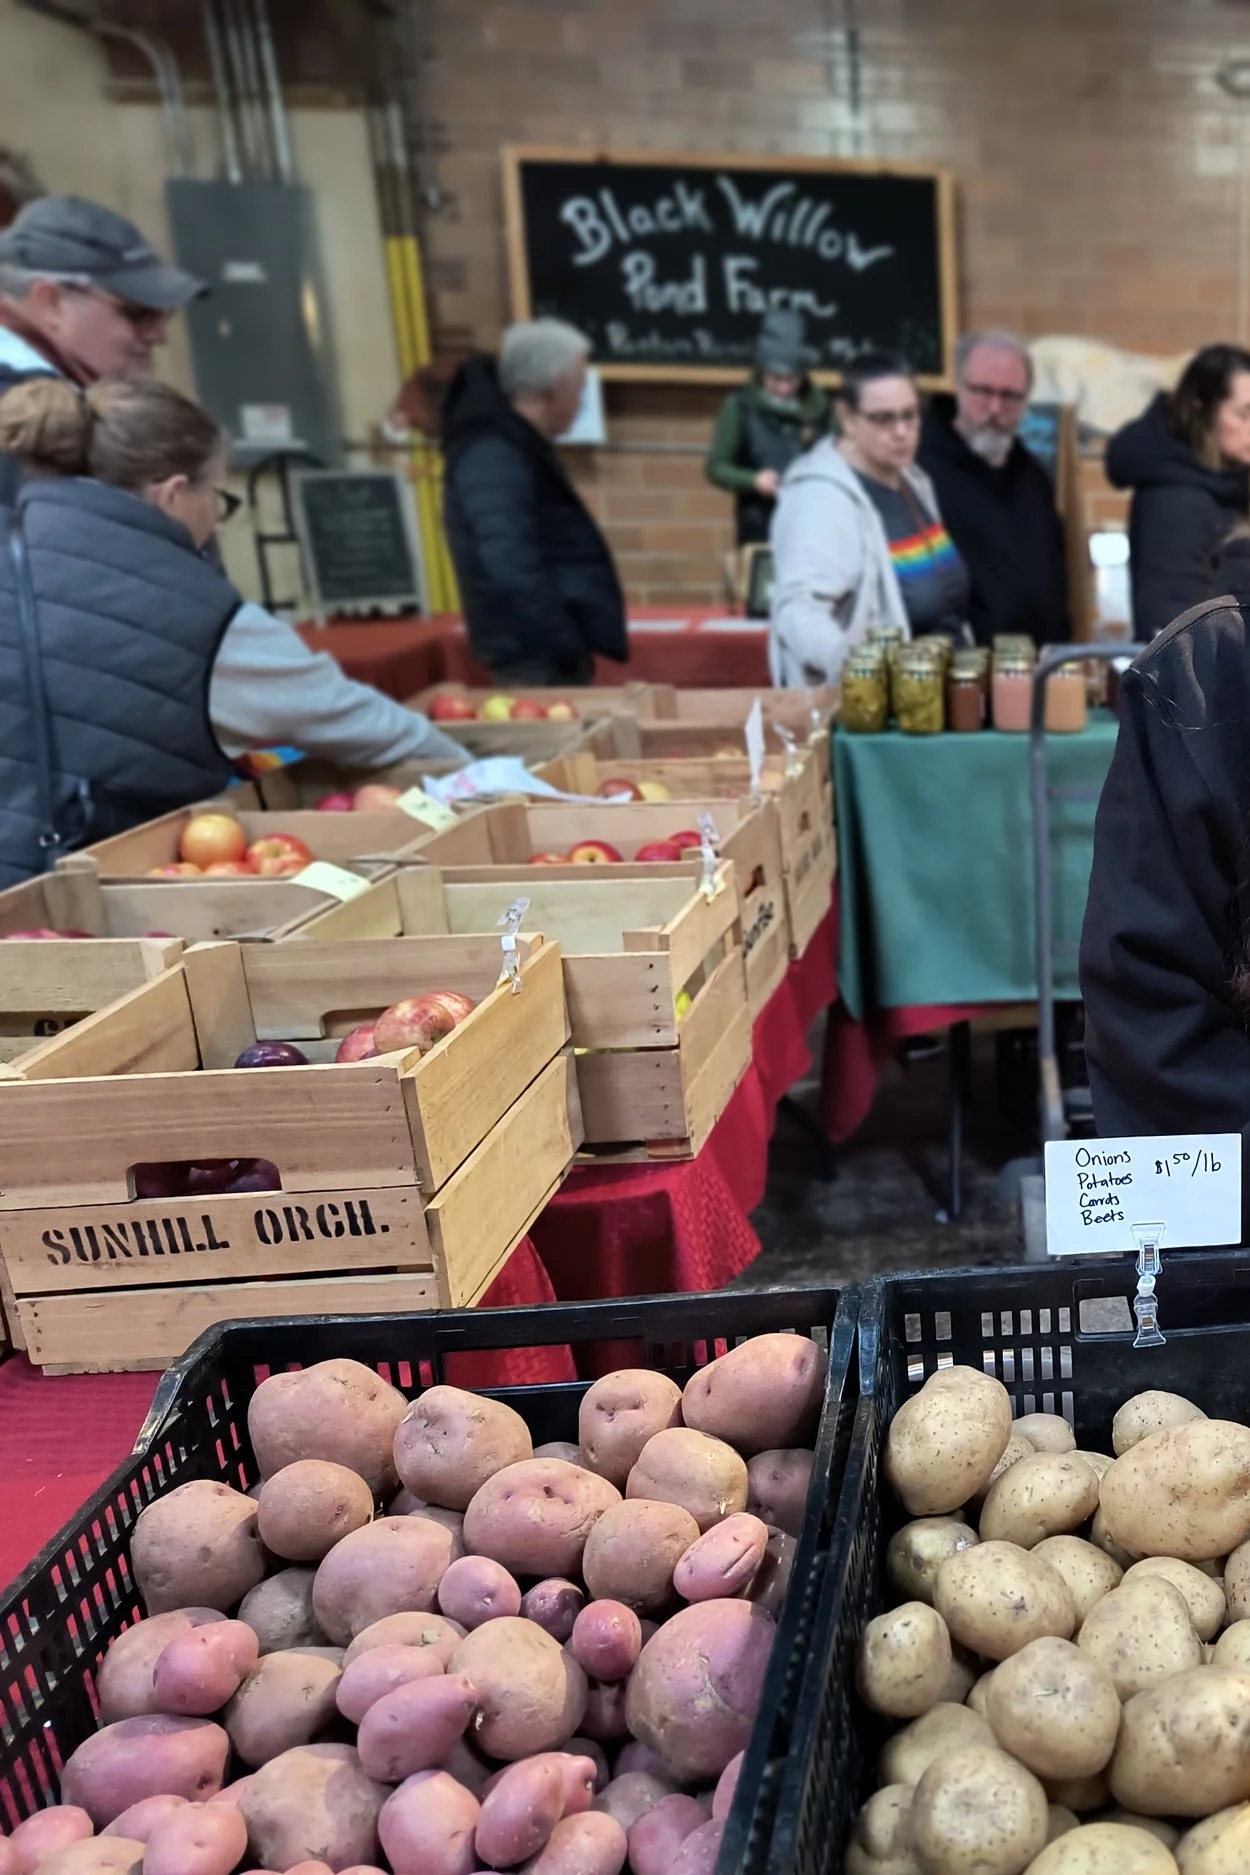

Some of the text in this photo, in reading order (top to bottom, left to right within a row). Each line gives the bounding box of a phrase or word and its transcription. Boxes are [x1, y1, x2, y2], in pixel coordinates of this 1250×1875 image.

[559, 174, 894, 272] Black Willow
[621, 250, 837, 318] Pond Farm
[1075, 1147, 1132, 1168] Onions
[1077, 1171, 1133, 1190] Potatoes
[41, 1199, 390, 1266] SUNHILL ORCH.
[1080, 1209, 1125, 1226] Beets
